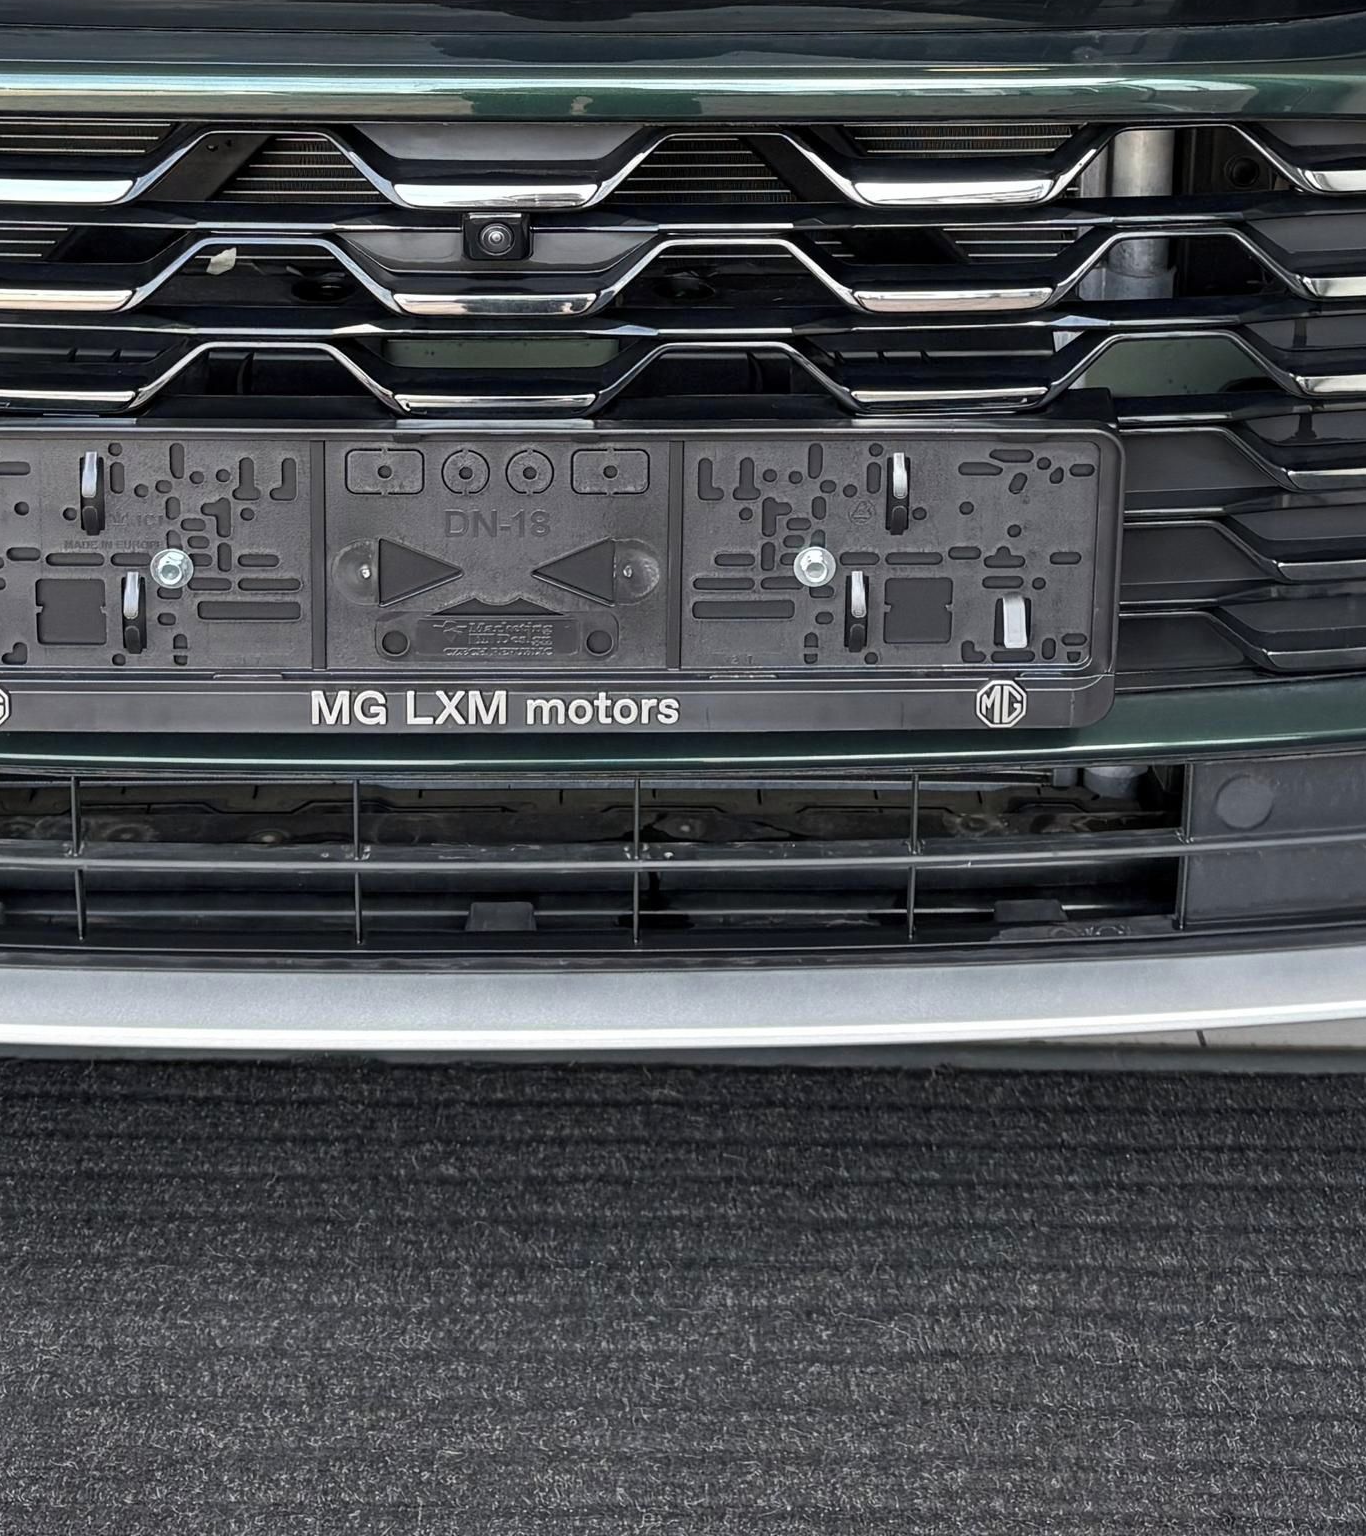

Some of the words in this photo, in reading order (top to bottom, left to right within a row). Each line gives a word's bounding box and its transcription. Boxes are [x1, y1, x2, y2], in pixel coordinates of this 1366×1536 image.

[443, 508, 551, 539] DN-18
[310, 690, 388, 726] MG
[406, 690, 508, 726] LXM
[526, 691, 680, 726] motors
[981, 684, 1023, 724] MG
